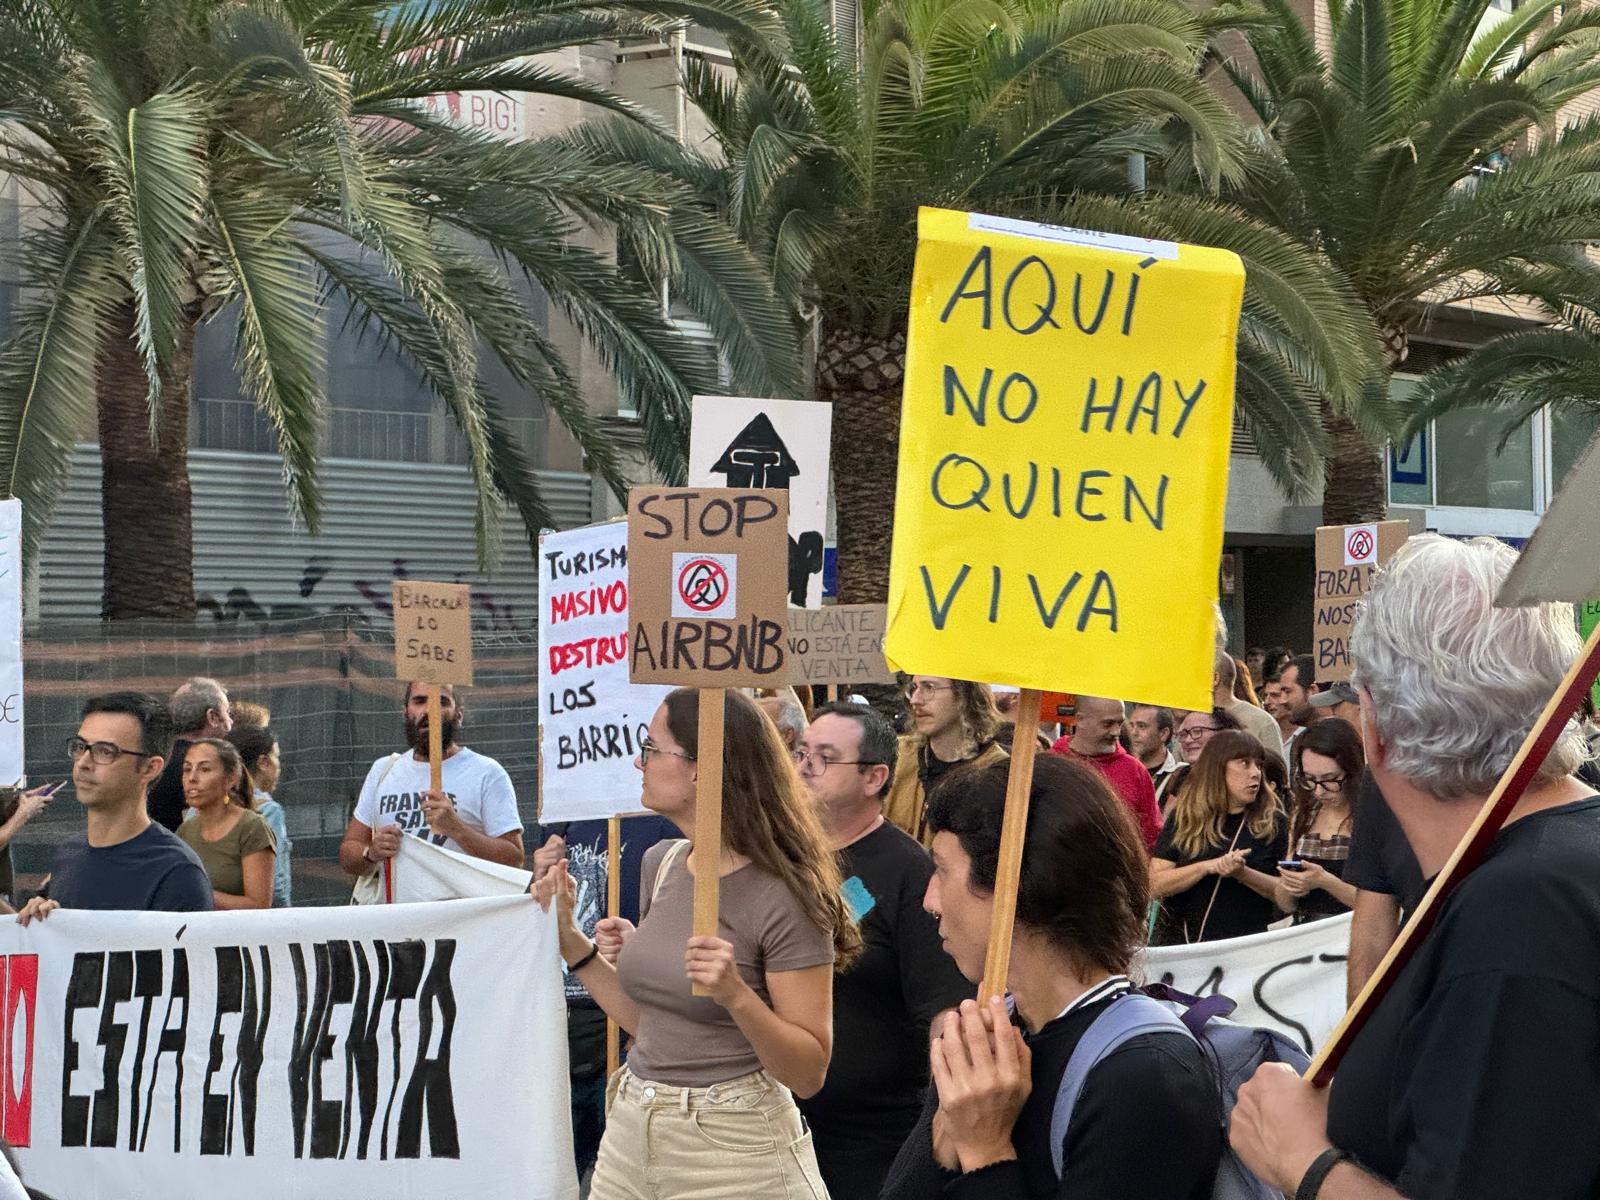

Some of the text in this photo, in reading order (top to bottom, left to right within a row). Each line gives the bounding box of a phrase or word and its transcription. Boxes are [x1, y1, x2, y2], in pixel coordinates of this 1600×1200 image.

[471, 94, 517, 132] BIG!
[940, 245, 1158, 336] AQUÍ
[943, 365, 1207, 438] NO HAY
[931, 453, 1169, 531] QUIEN
[638, 492, 778, 541] STOP
[545, 545, 628, 580] TURISM
[920, 564, 1119, 633] VIVA
[1317, 566, 1363, 598] FORA
[416, 615, 439, 631] LO
[787, 609, 875, 633] LICANTE
[1318, 603, 1360, 625] NOS
[406, 638, 456, 664] SABE
[550, 632, 629, 675] DESTRU
[632, 614, 786, 675] AIRBNB
[815, 633, 853, 655] ESTÁ
[857, 633, 884, 654] EN
[800, 658, 871, 680] VENTA
[550, 681, 597, 715] LOS
[61, 924, 191, 1153] ESTÁ
[200, 944, 272, 1157] EN
[288, 939, 461, 1160] VENTA
